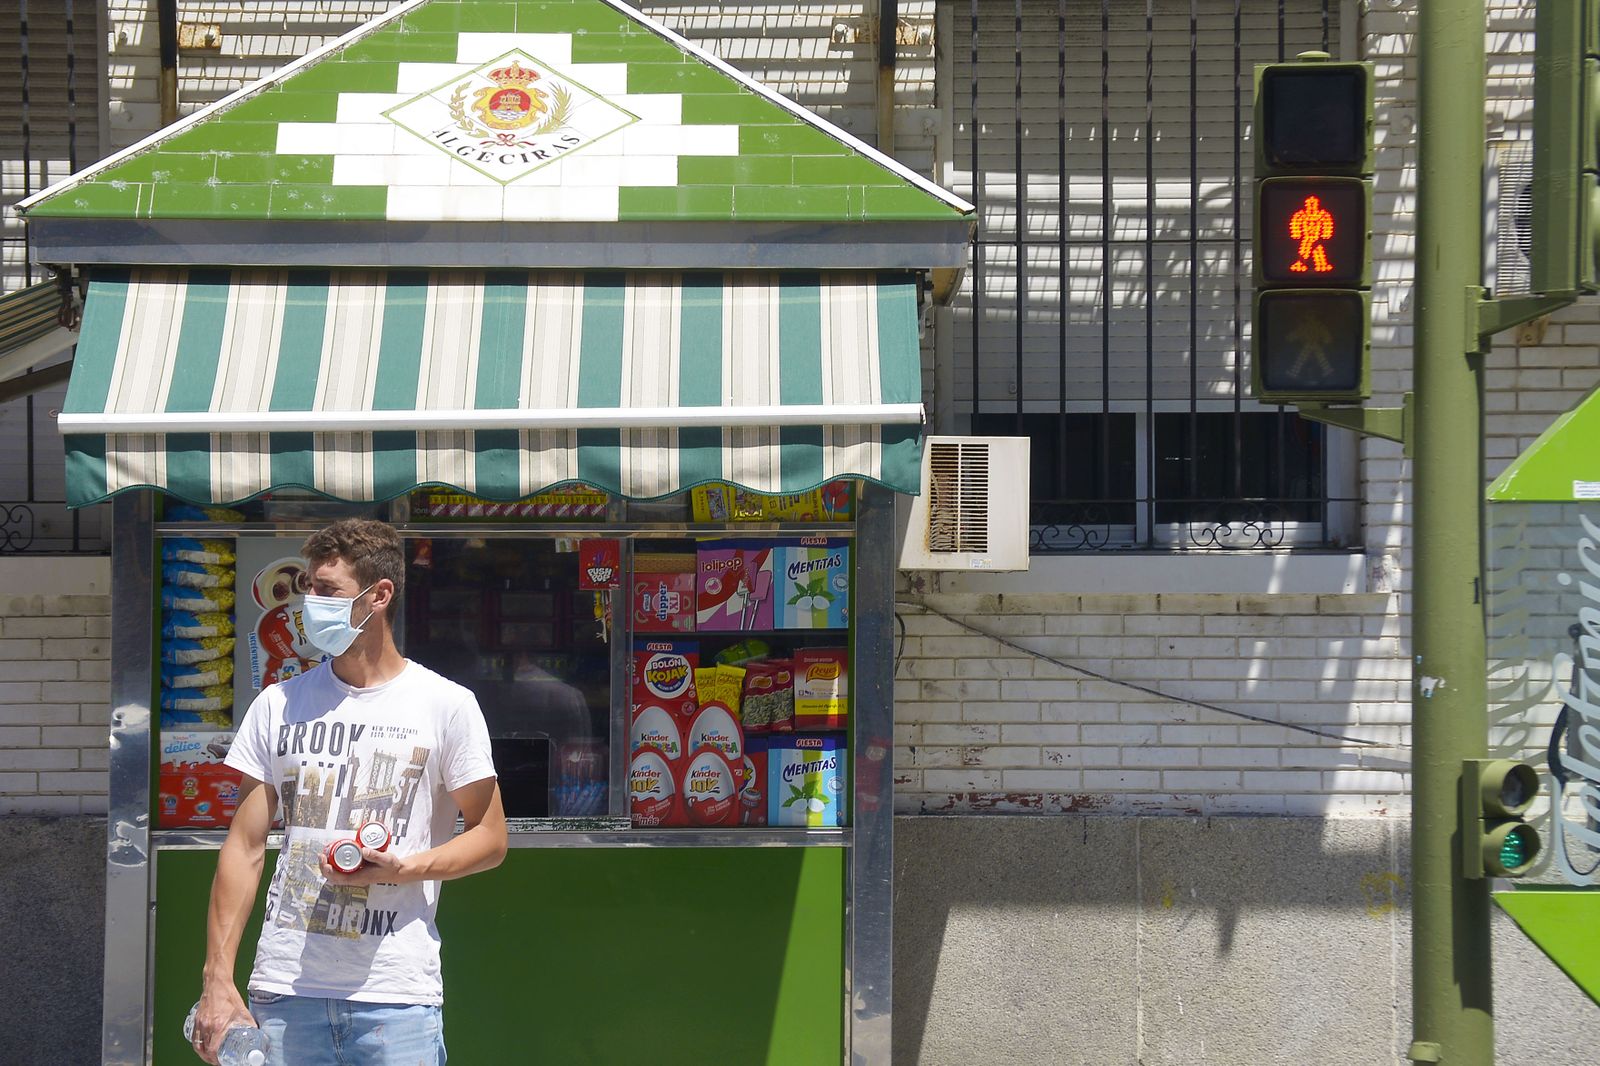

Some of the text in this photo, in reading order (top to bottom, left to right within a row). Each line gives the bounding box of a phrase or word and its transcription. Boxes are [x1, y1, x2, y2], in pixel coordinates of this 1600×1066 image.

[432, 130, 580, 165] ALGECIRAS
[800, 536, 827, 545] FIESTA
[587, 567, 612, 577] PUSH
[701, 557, 743, 573] lolipop
[591, 574, 610, 583] POP
[656, 581, 669, 621] dipper
[669, 594, 678, 610] XL
[646, 642, 673, 651] FIESTA
[651, 657, 682, 670] BOLÓN
[646, 665, 689, 683] KOJAK
[164, 741, 201, 754] délice
[796, 738, 823, 747] FIESTA
[690, 778, 719, 793] JOY
[325, 903, 398, 937] BRONX
